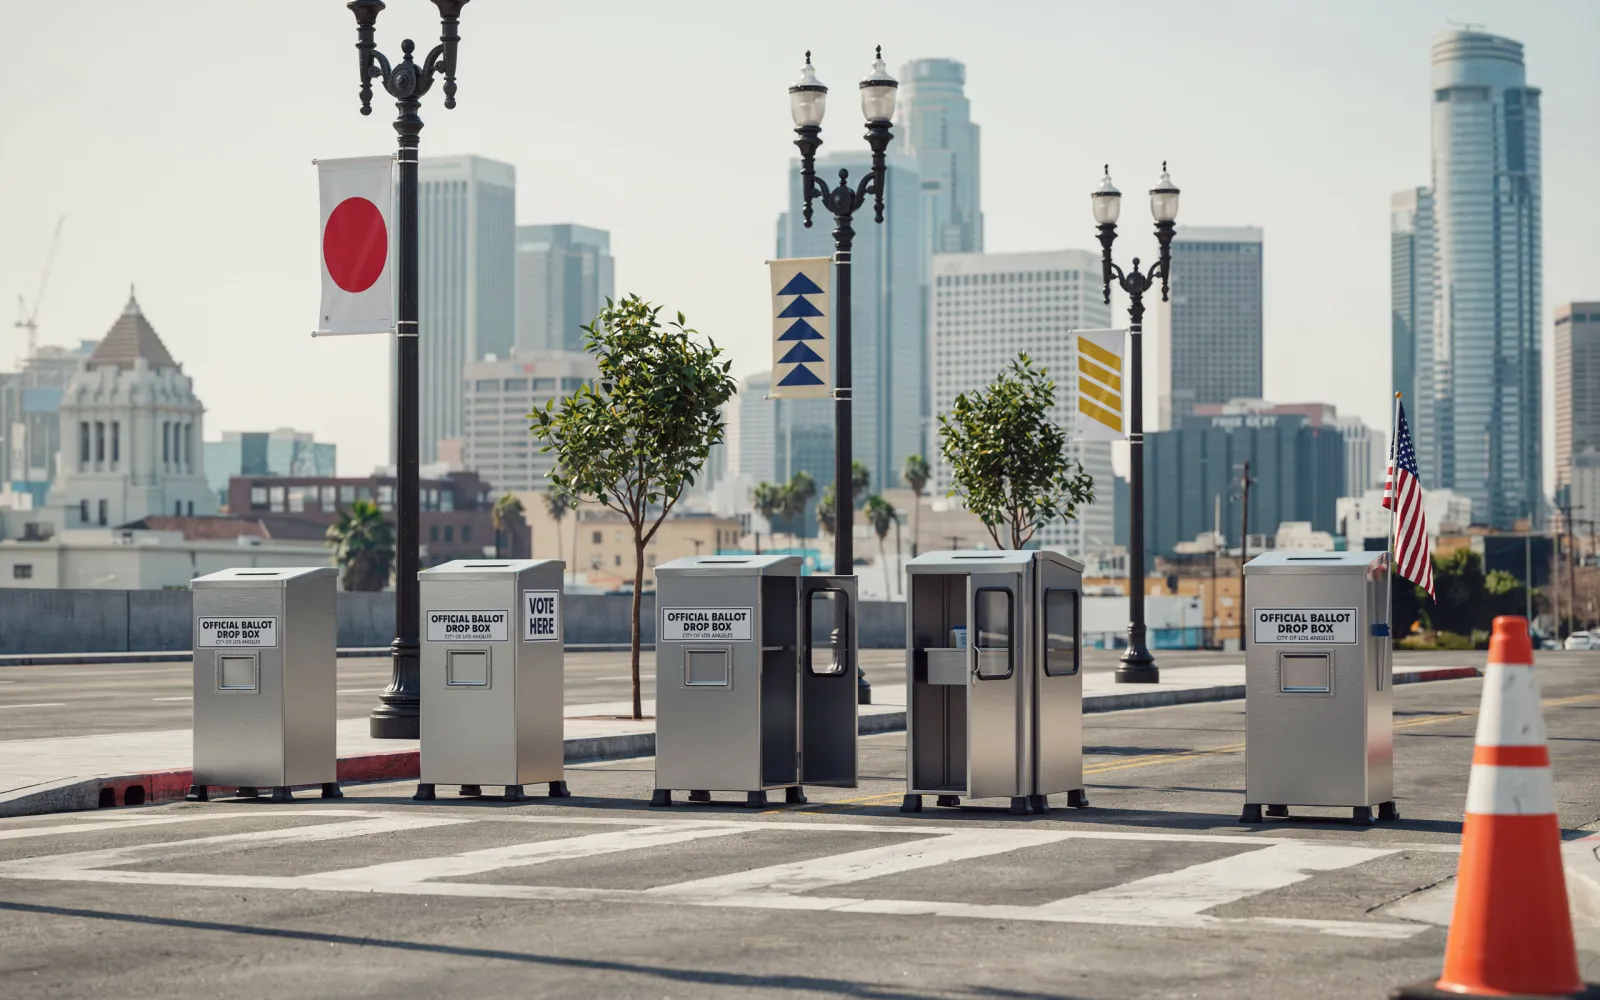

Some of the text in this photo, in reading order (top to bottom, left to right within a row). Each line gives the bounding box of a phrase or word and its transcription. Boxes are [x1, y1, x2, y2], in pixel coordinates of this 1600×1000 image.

[529, 598, 554, 614] VOTE
[431, 615, 504, 623] OFFICIAL BALLOT
[668, 613, 746, 621] OFFICIAL BALLOT
[1260, 614, 1350, 622] OFFICIAL BALLOT
[202, 620, 272, 629] OFFICIAL BALLOT
[530, 618, 554, 634] HERE
[684, 623, 732, 631] DROP BOX
[1278, 624, 1333, 633] DROP BOX
[242, 630, 260, 638] BOX
